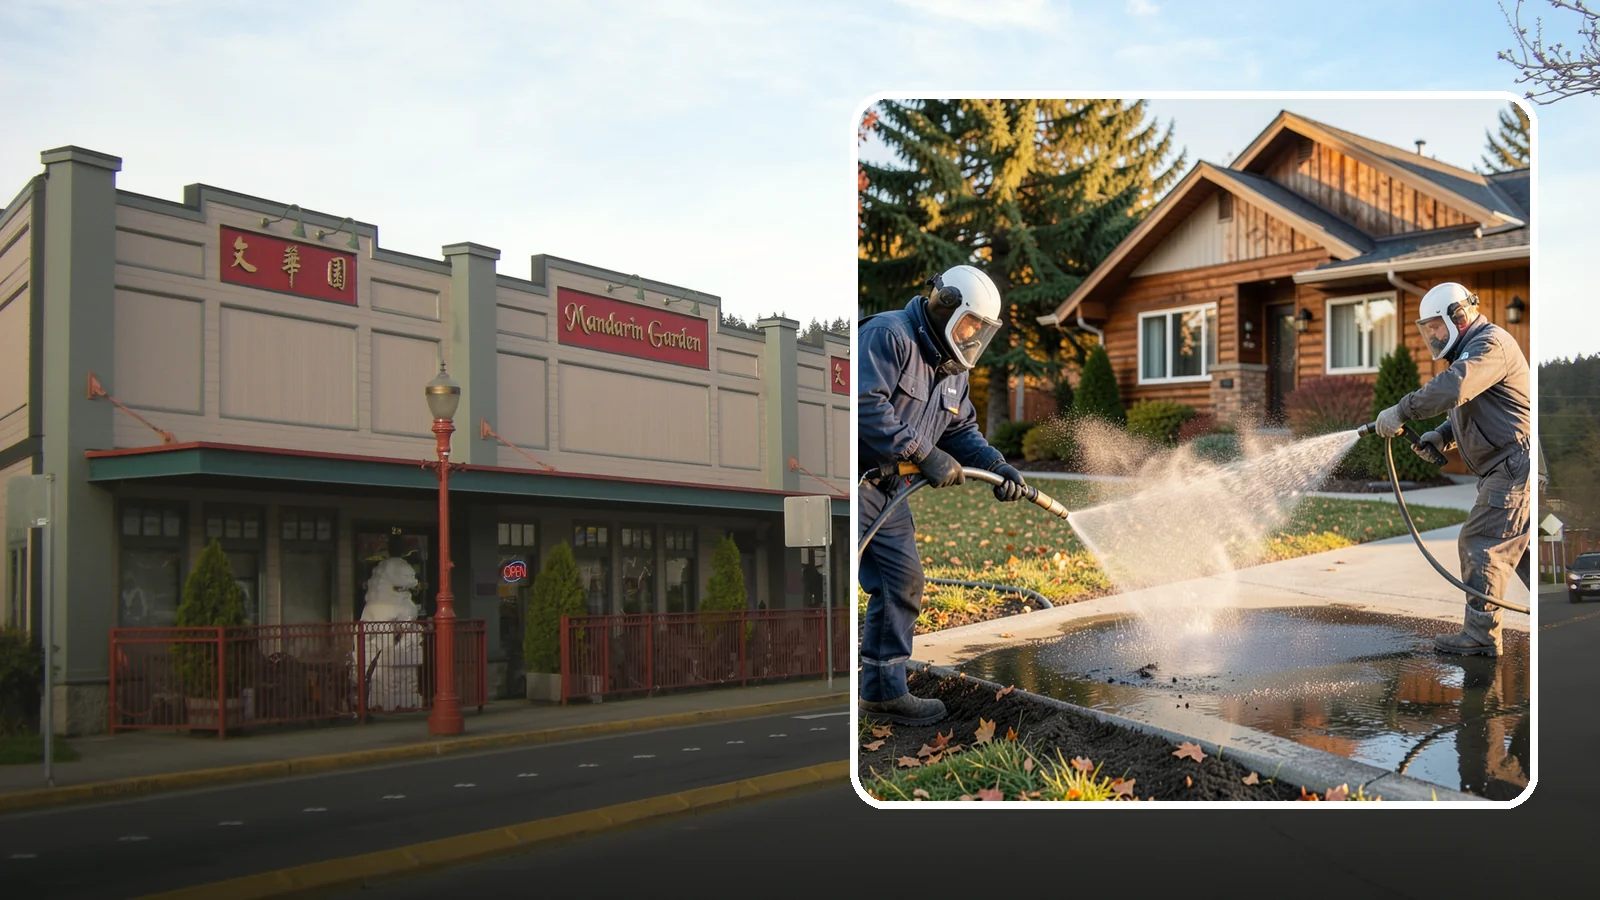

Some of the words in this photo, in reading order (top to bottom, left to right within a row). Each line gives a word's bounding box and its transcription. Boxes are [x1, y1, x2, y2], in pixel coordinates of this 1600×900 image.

[230, 235, 346, 291] 文華園
[564, 302, 644, 341] Mandarin
[647, 320, 701, 352] Garden
[503, 565, 527, 578] OPEN
